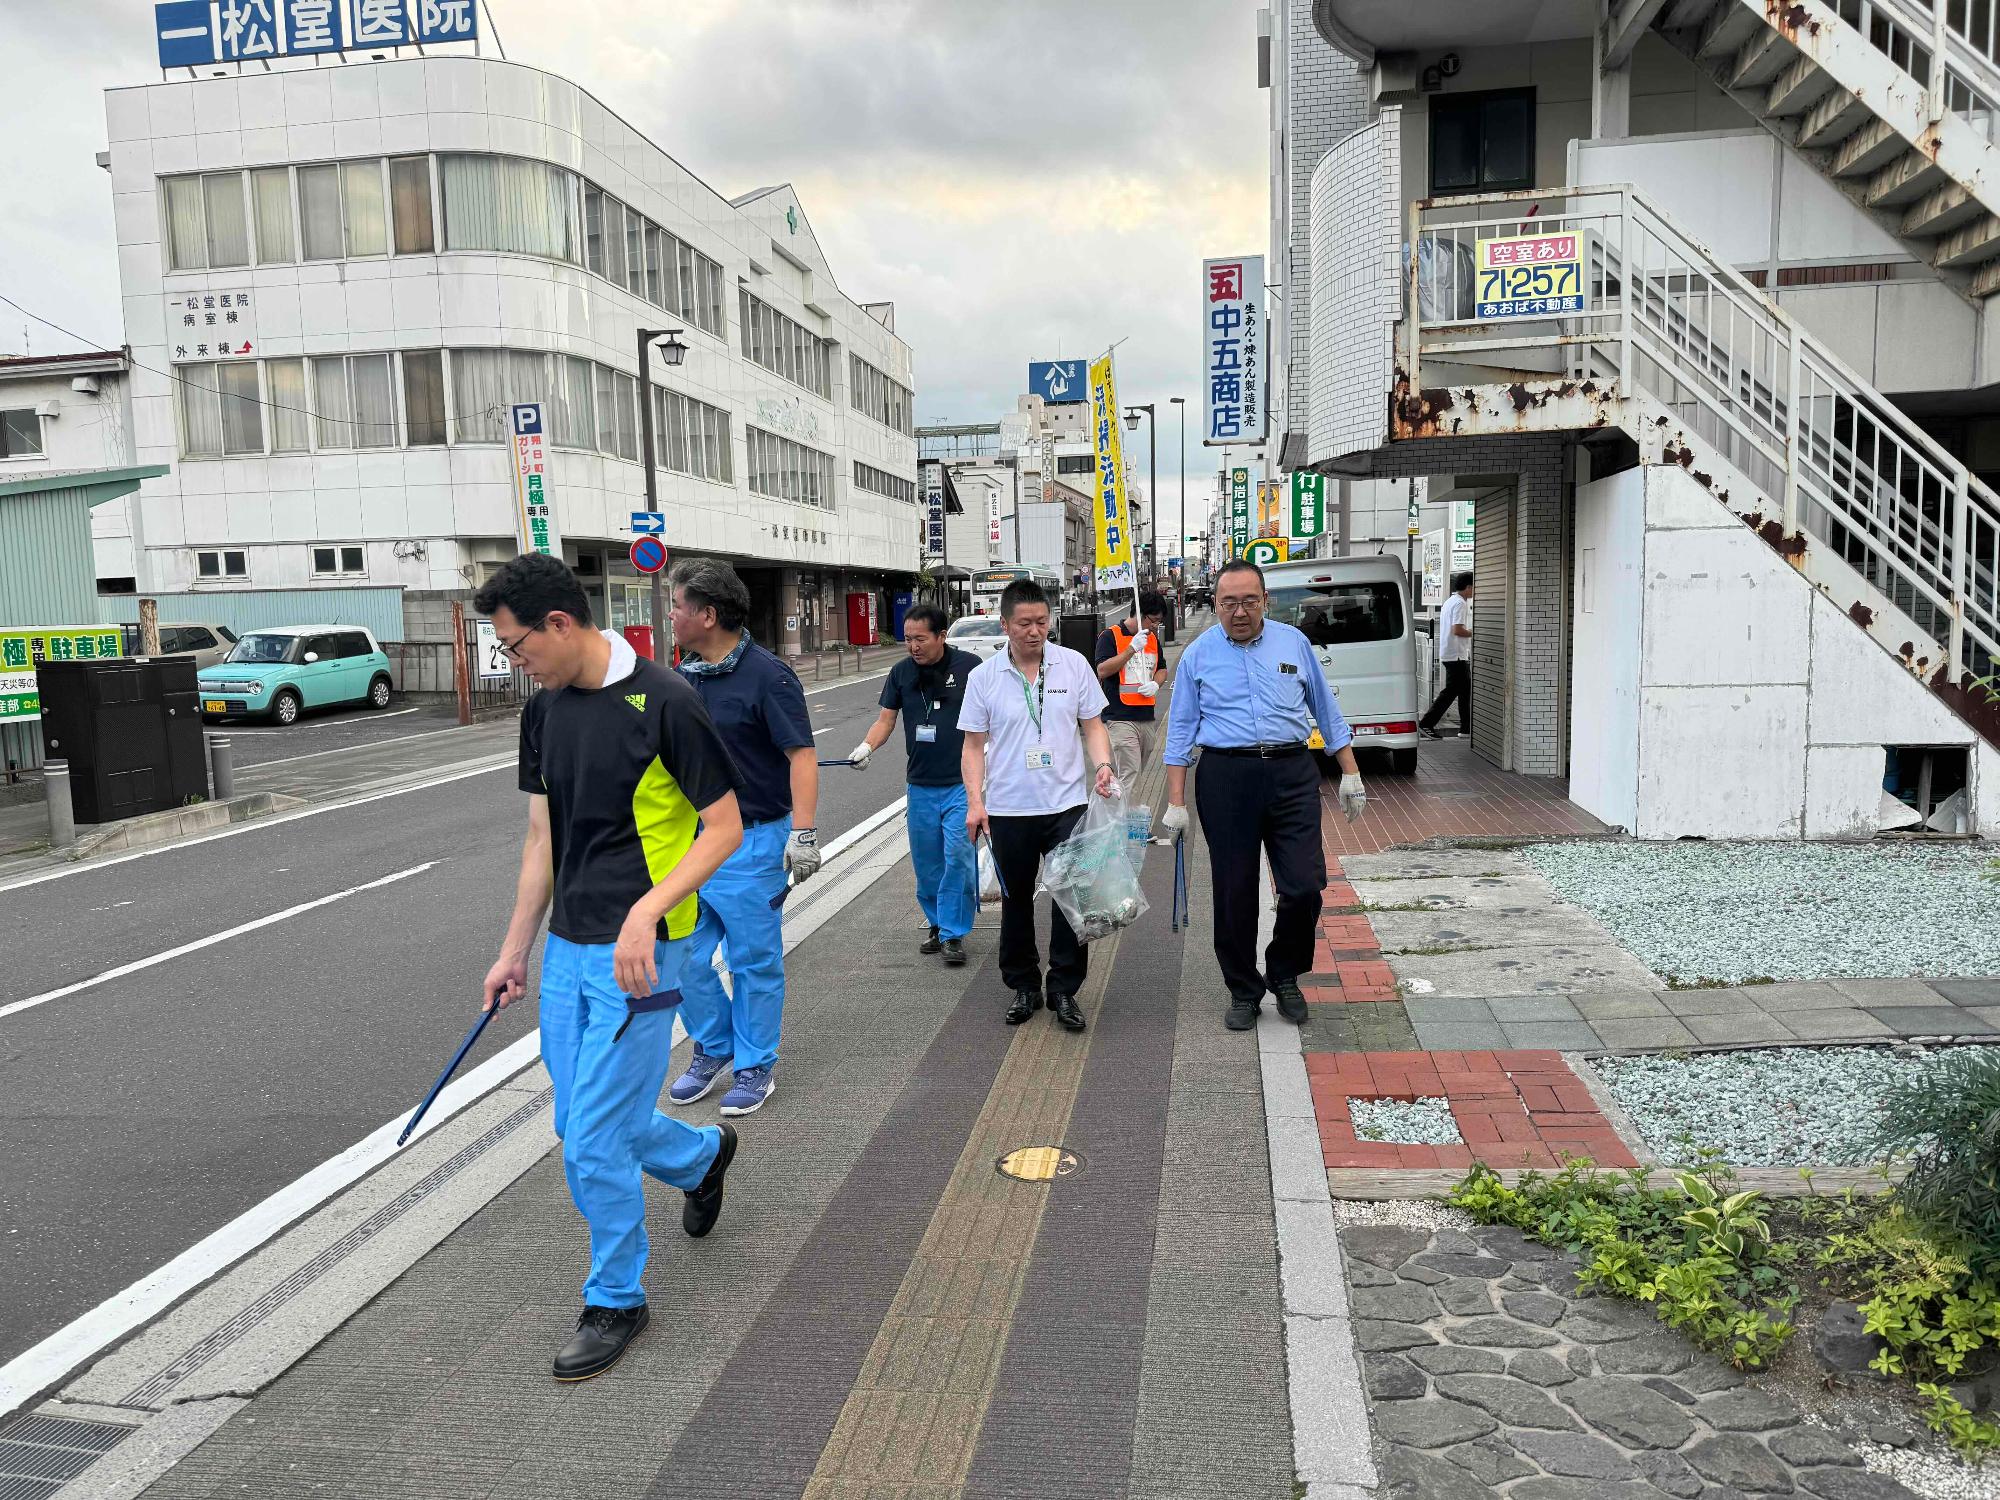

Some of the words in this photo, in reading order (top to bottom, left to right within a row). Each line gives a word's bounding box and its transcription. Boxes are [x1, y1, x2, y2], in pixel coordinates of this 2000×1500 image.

[161, 0, 472, 57] 一松堂医院
[1493, 239, 1572, 264] 空室あり
[171, 294, 249, 310] 一松堂医院
[1483, 297, 1577, 315] あおば不動産
[184, 311, 239, 327] 病室棟
[176, 342, 230, 358] 外来棟
[1211, 304, 1242, 438] 中五商店
[517, 409, 537, 432] P
[518, 437, 531, 475] ガレージ
[1095, 383, 1120, 554] 清掃活動中
[528, 474, 545, 505] 月極
[527, 506, 549, 516] 専用
[1255, 546, 1274, 566] P
[2, 638, 28, 667] 極
[50, 634, 118, 660] 駐車場
[0, 678, 38, 690] 天災等の
